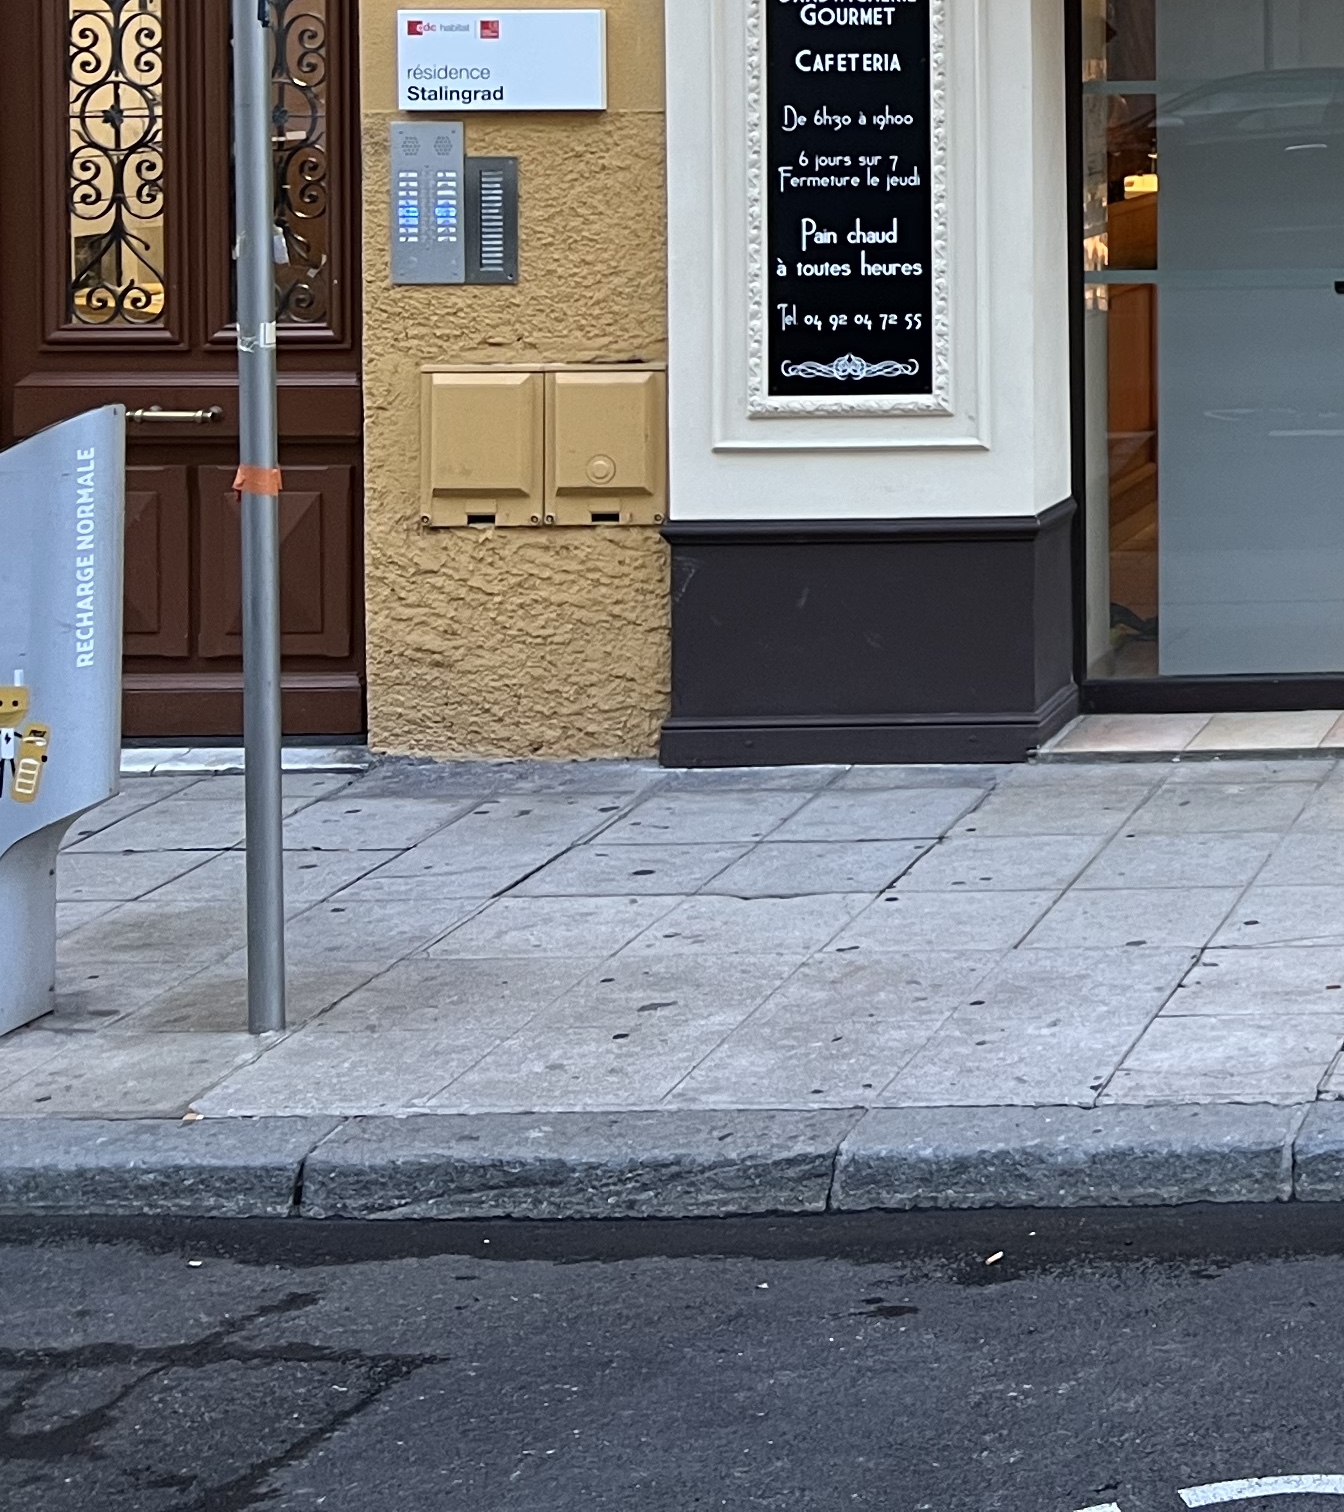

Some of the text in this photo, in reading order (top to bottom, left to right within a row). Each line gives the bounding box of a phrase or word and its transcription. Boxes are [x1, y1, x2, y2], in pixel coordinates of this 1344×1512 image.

[799, 3, 897, 28] GOURMET
[407, 64, 491, 80] résidence
[794, 48, 902, 74] CAFETERIA
[407, 86, 504, 104] Stalingrad
[781, 104, 914, 131] De 6h30 à 19h00
[798, 150, 899, 172] 6 jours sur 7
[778, 165, 920, 193] Fermeture le jeudi
[801, 217, 898, 252] Pain chaud
[776, 249, 923, 276] à toutes heures
[804, 314, 823, 331] 04
[829, 314, 848, 331] 92
[853, 314, 872, 331] 04
[879, 313, 898, 331] 72
[904, 313, 922, 330] 55
[76, 446, 96, 669] RECHARGE NORMALE
